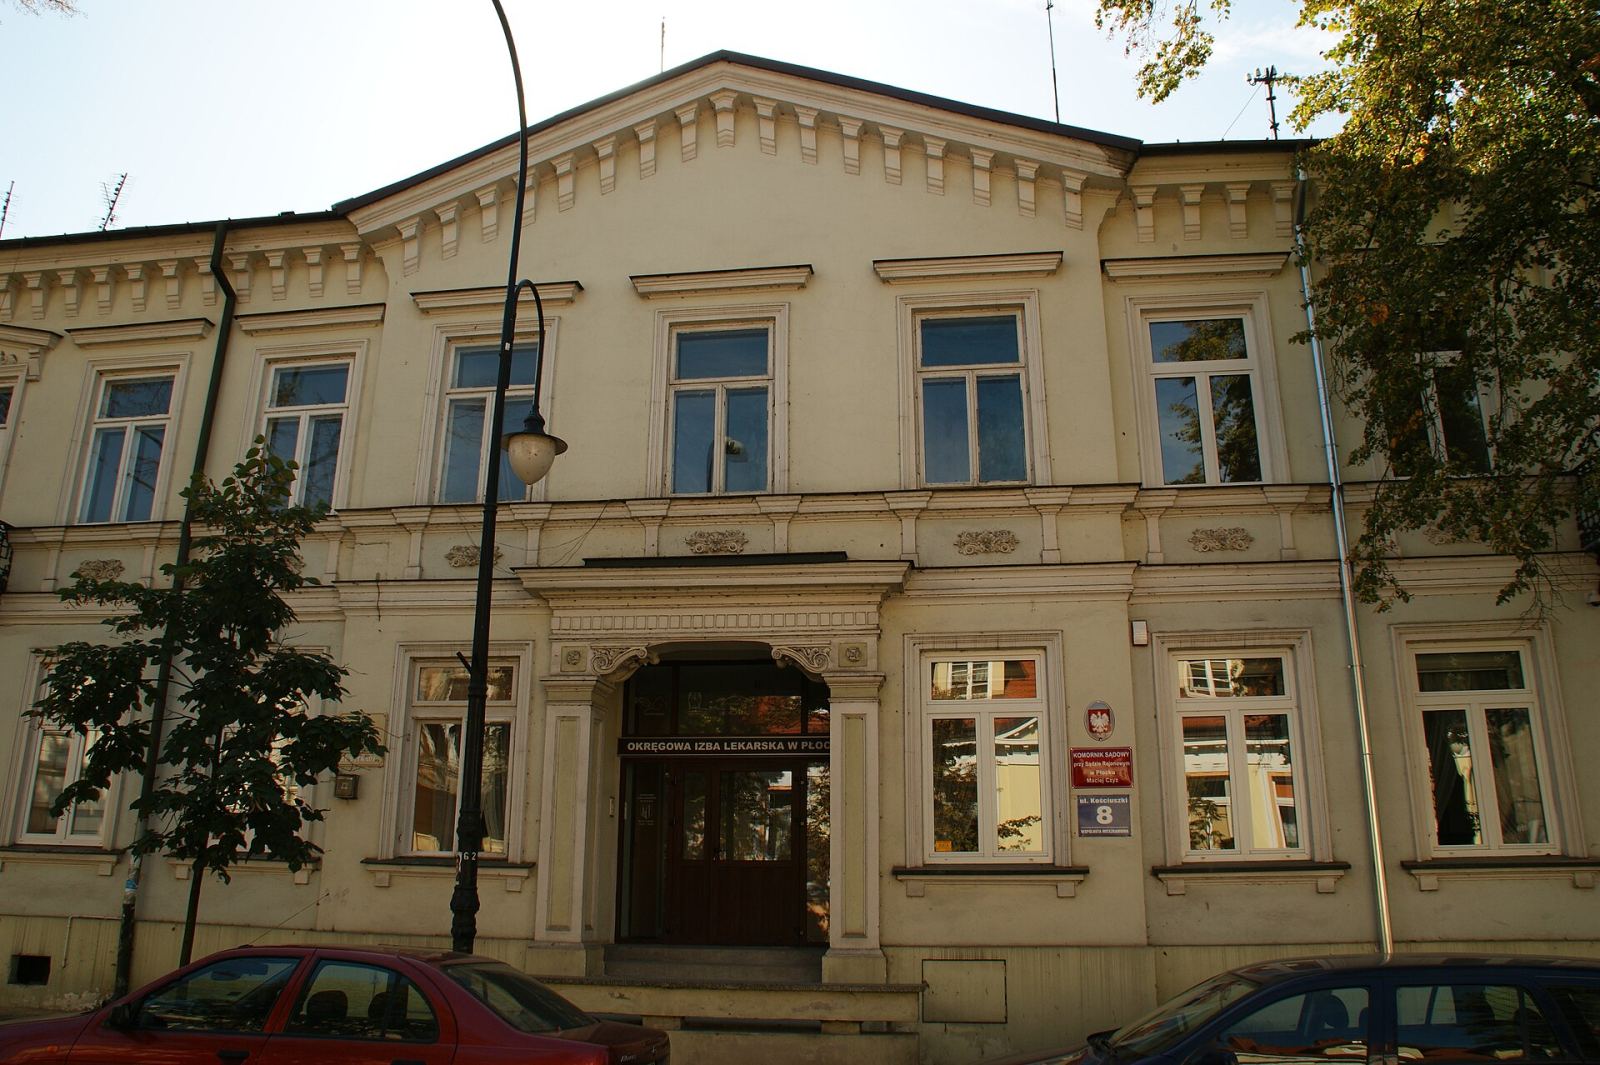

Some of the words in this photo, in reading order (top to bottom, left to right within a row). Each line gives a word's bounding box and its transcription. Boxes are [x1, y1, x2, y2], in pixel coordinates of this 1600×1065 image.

[627, 742, 691, 753] OKRĘGOWA
[694, 742, 720, 751] IZBA
[724, 742, 784, 751] LEKARSKA
[787, 741, 798, 750] W
[1096, 805, 1113, 825] 8
[463, 851, 477, 860] 62
